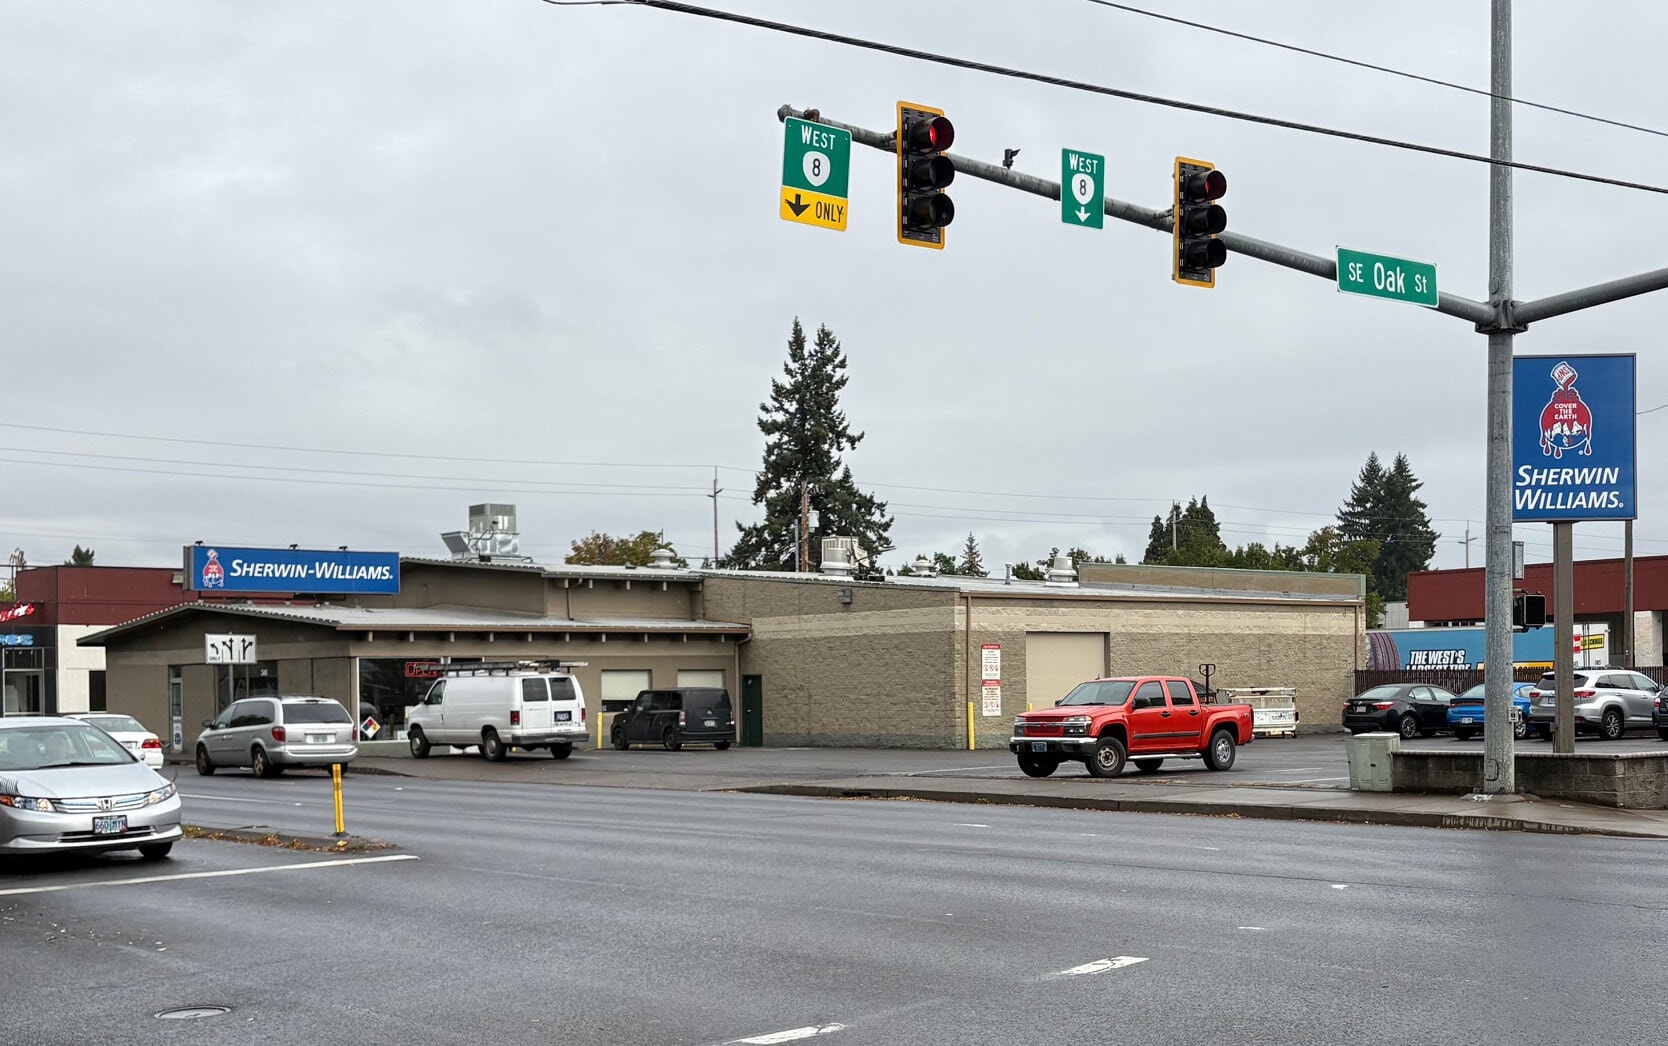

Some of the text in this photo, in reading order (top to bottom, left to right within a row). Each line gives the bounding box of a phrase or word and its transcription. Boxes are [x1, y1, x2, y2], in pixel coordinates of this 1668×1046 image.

[801, 125, 836, 150] WEST
[812, 158, 821, 177] 8
[1069, 153, 1098, 174] WEST
[1079, 179, 1087, 196] 8
[815, 201, 844, 223] ONLY
[1348, 262, 1427, 294] SE Oak St
[1515, 465, 1619, 487] SHERWIN
[1410, 650, 1465, 665] THE WEST'S
